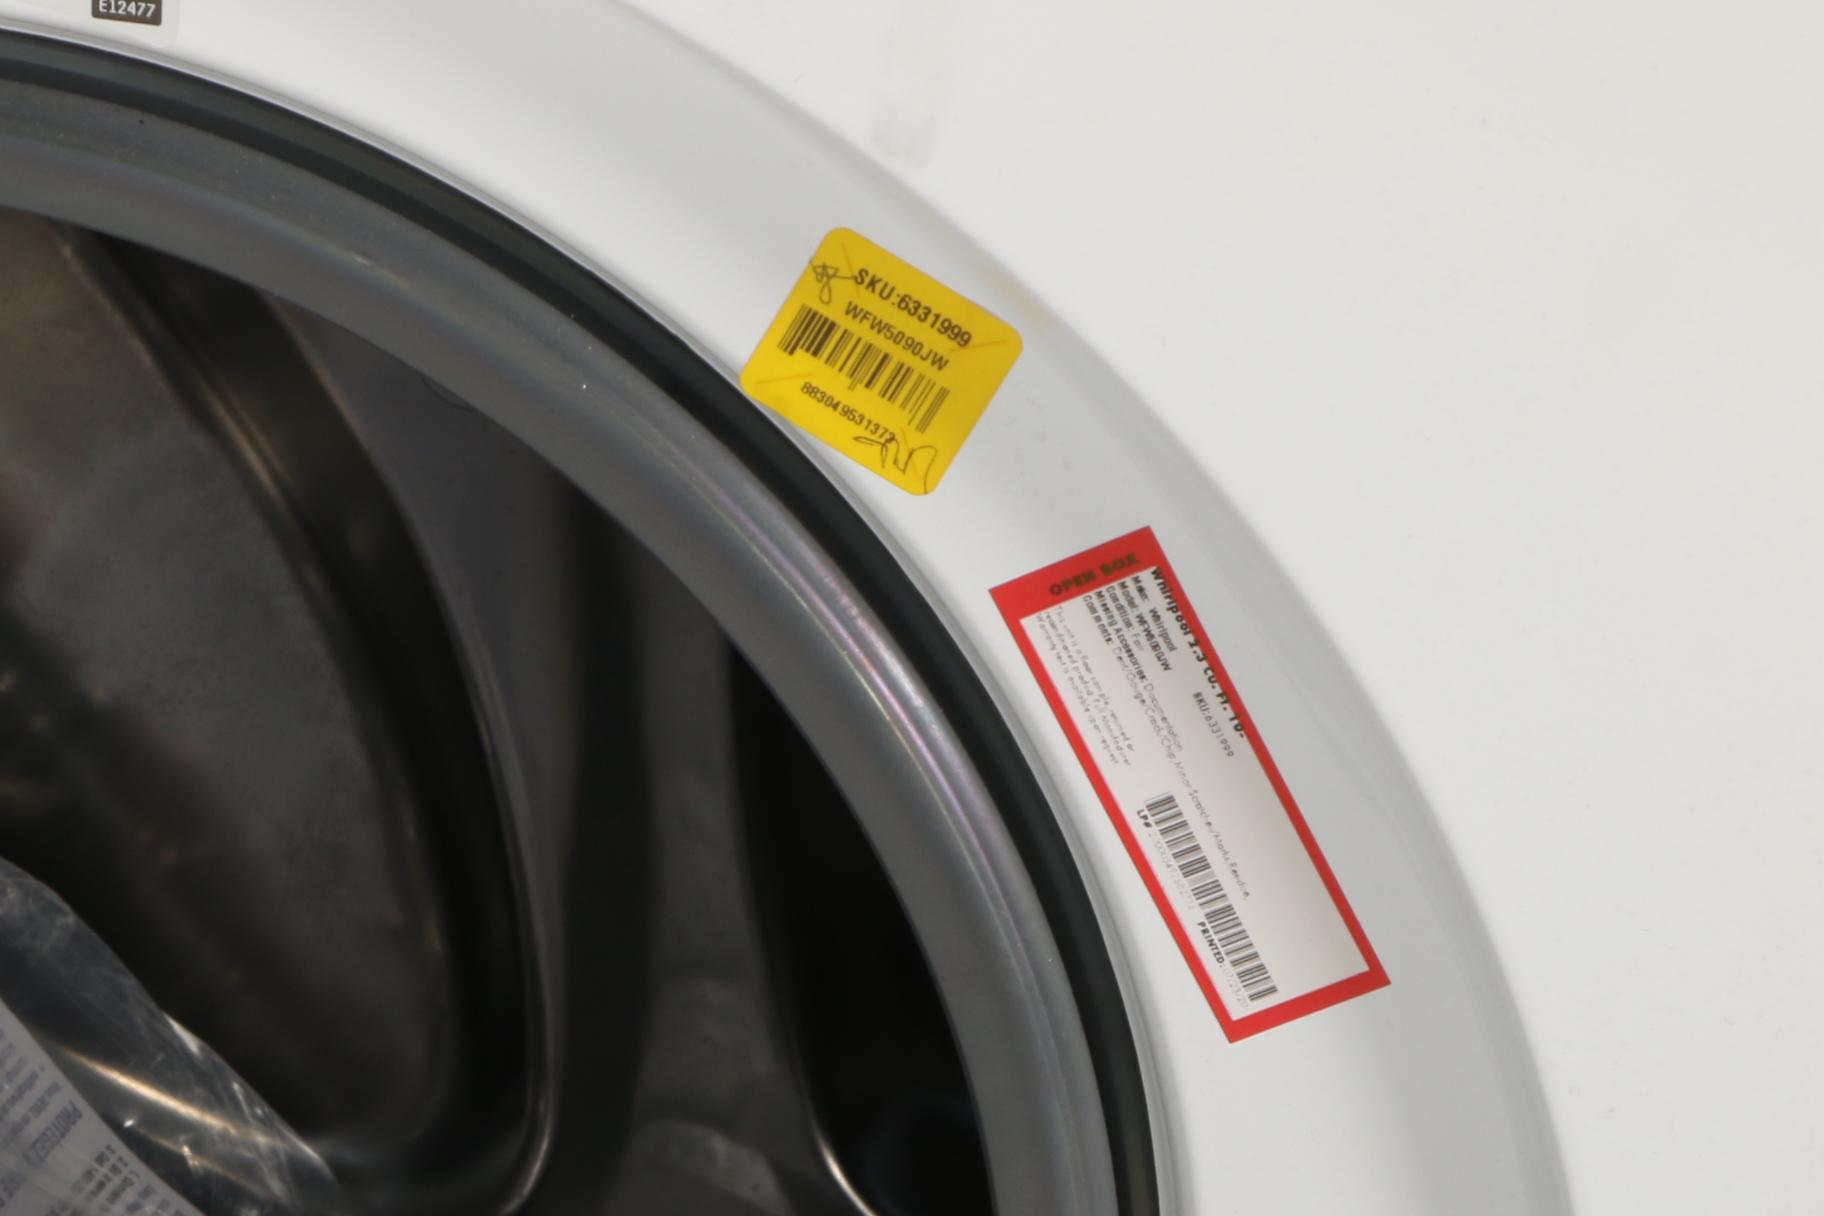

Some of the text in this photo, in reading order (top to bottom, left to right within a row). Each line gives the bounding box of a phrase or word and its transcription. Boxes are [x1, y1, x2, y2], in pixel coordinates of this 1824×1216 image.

[98, 0, 156, 18] E12477
[853, 268, 971, 348] SKU:6331999
[845, 301, 949, 370] WFW5090JW
[1048, 568, 1098, 597] OPEN
[1116, 579, 1141, 614] Model:
[1104, 584, 1137, 633] Condition:
[1145, 606, 1178, 655] Whirlpool
